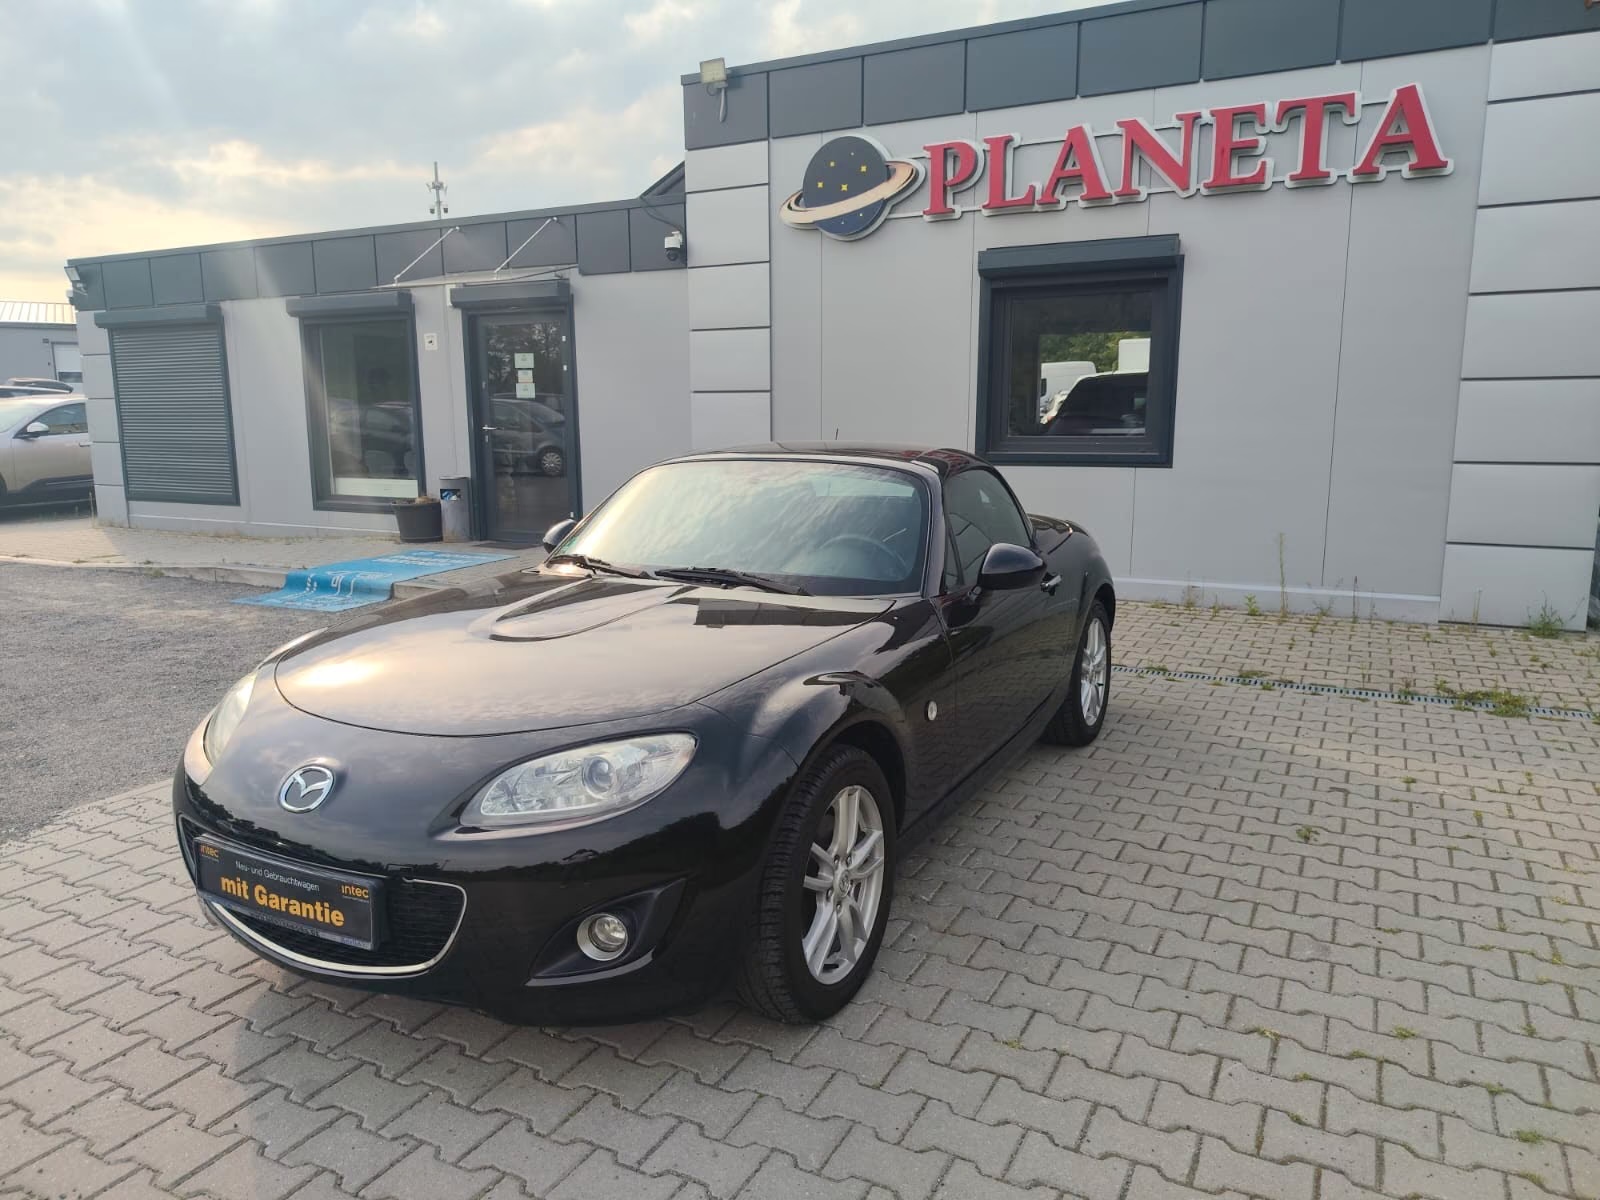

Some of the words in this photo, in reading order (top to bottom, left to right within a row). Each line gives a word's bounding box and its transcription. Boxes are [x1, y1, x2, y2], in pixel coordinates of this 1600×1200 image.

[921, 83, 1450, 218] PLANETA
[251, 867, 263, 877] und
[263, 869, 321, 892] Gebrauchtwagen
[341, 884, 369, 899] intec
[220, 876, 249, 900] mit
[254, 884, 345, 927] Garantie
